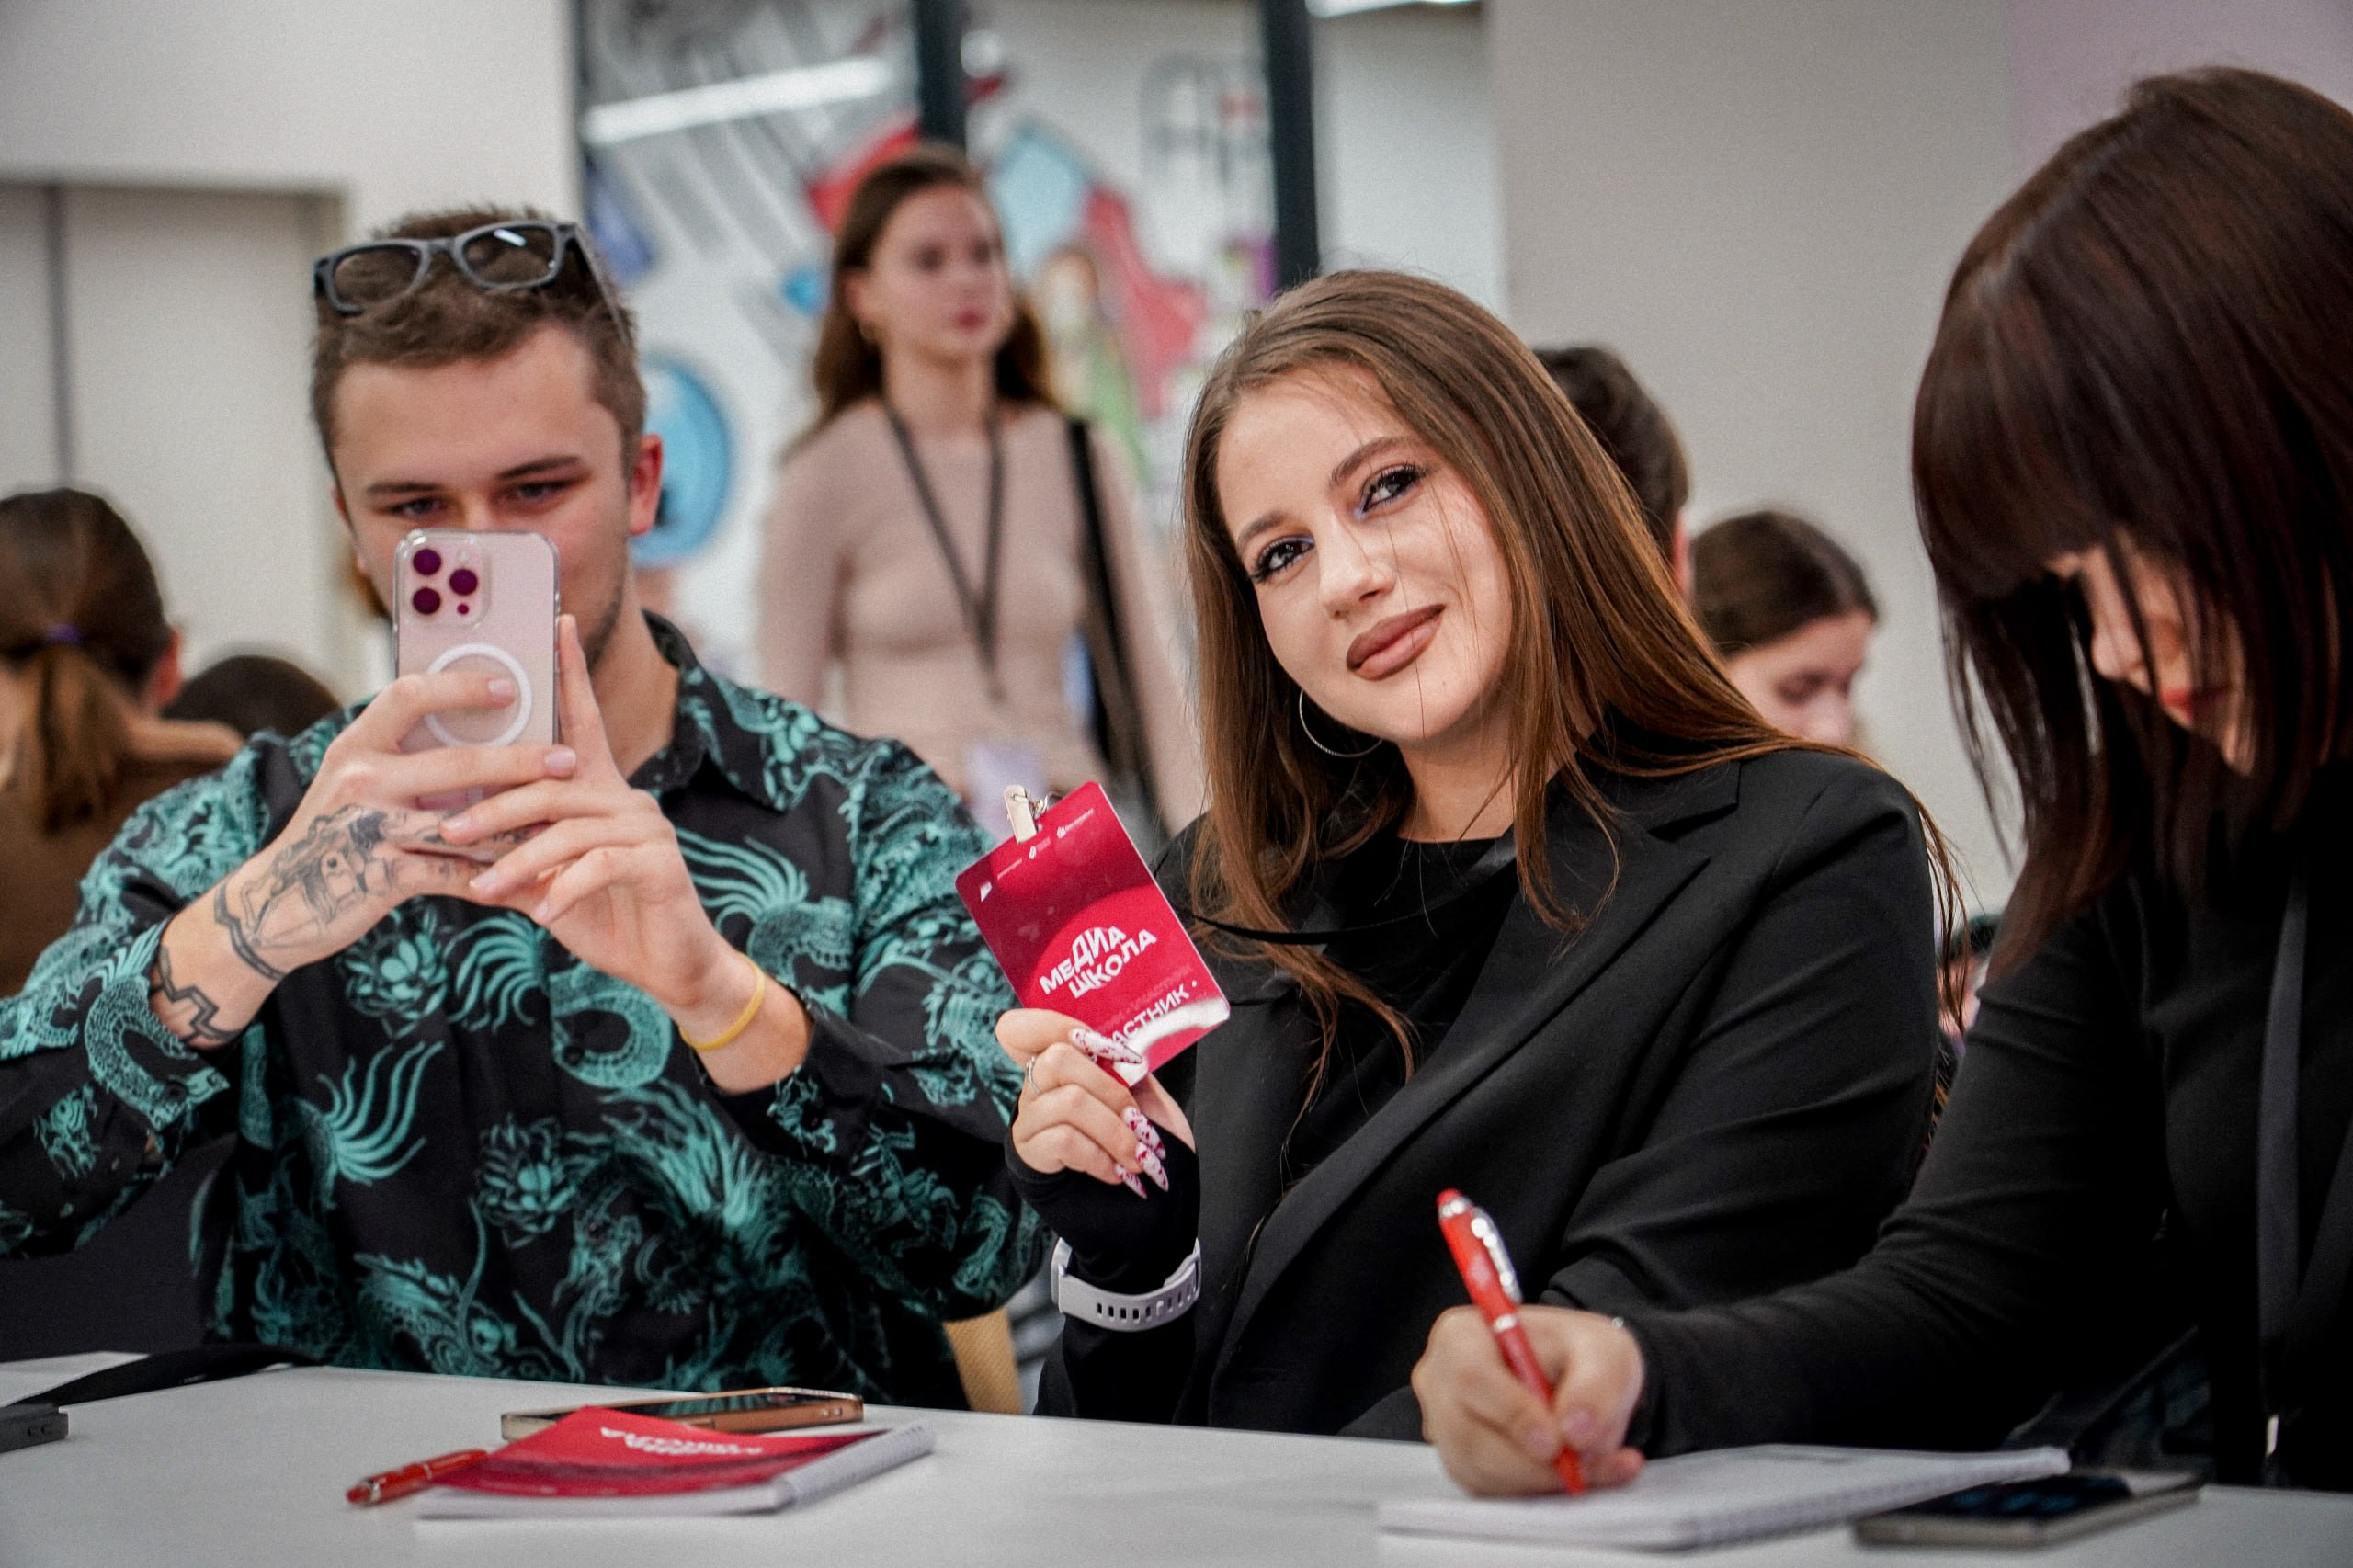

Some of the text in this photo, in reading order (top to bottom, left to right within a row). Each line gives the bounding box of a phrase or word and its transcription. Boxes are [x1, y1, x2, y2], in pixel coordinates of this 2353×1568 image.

[1039, 926, 1127, 994] МЕДИА
[1068, 929, 1157, 999] ШКОЛА
[1099, 983, 1190, 1053] АСТНИК
